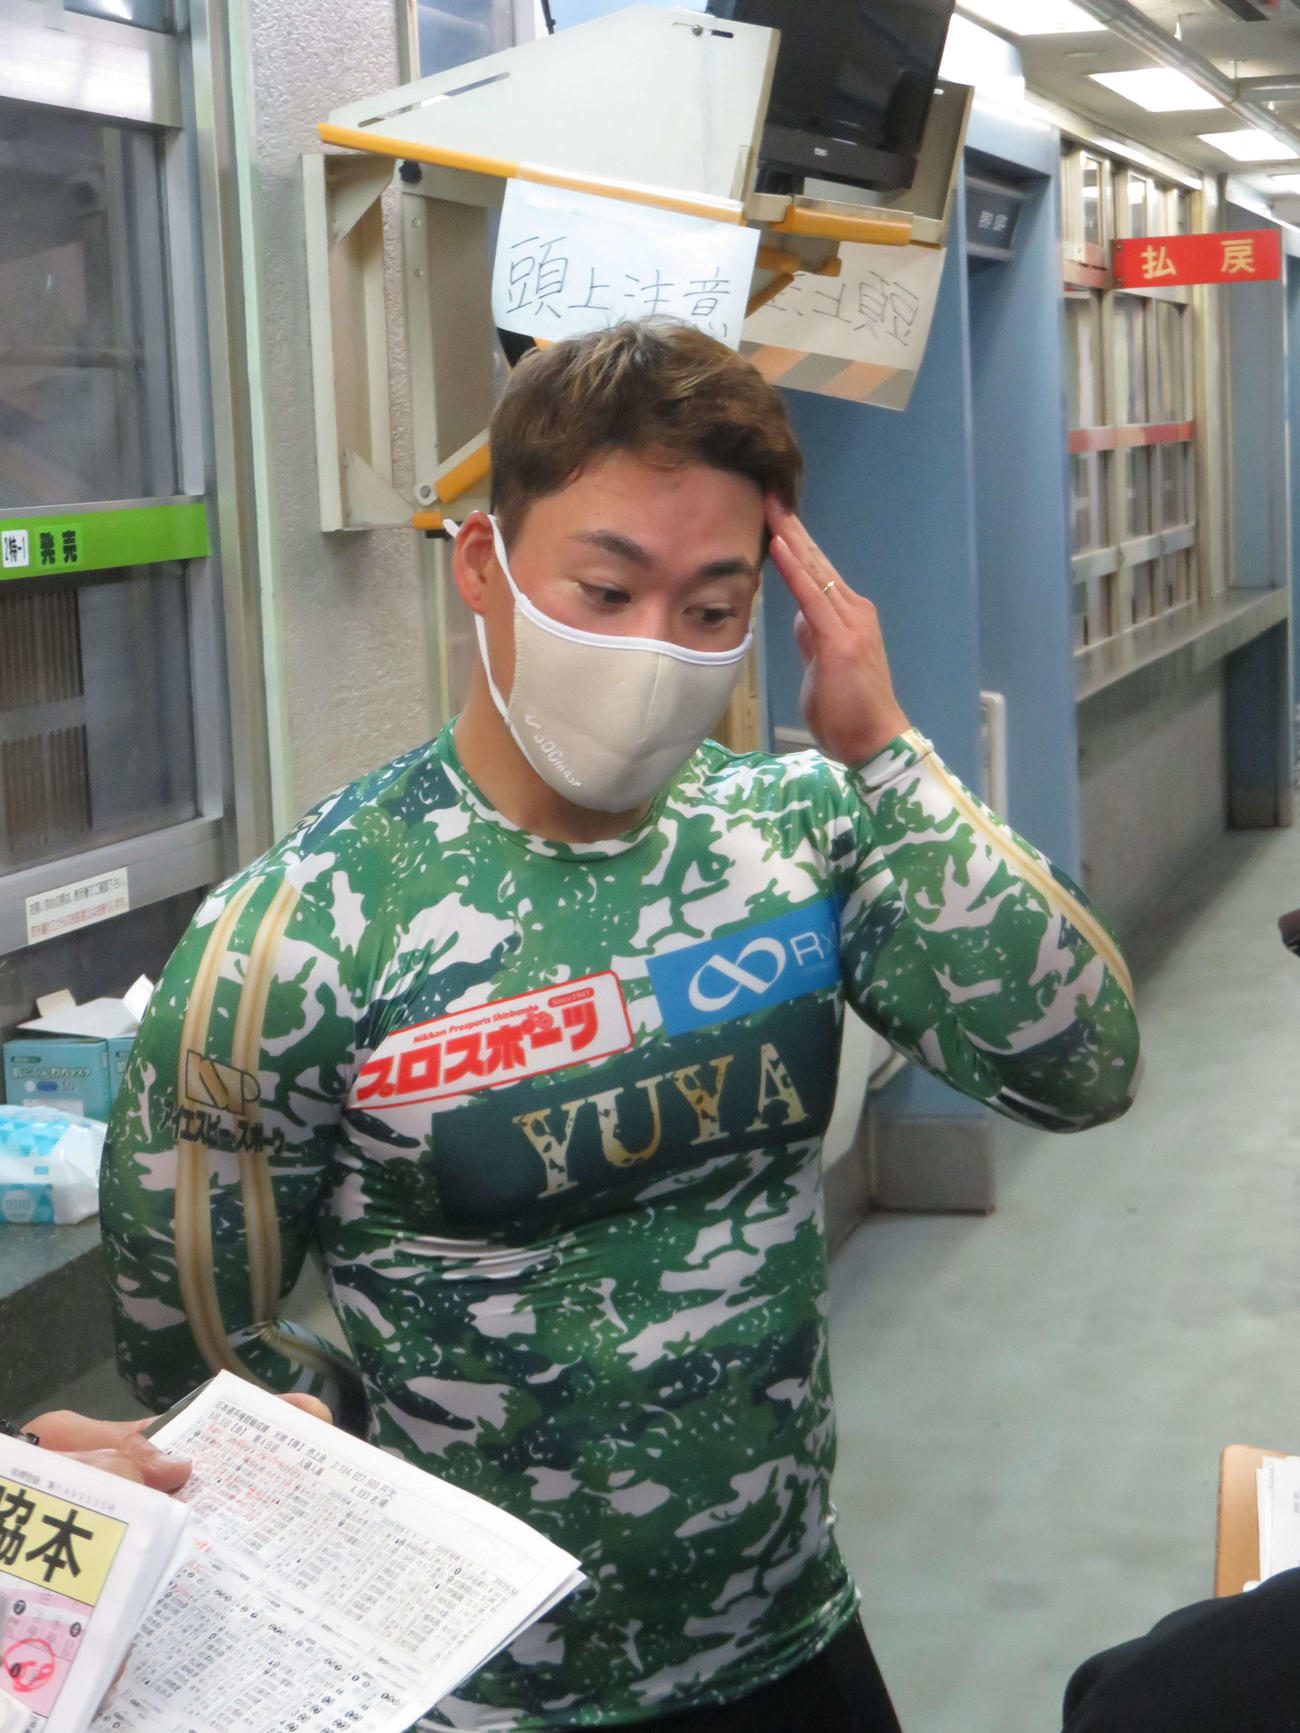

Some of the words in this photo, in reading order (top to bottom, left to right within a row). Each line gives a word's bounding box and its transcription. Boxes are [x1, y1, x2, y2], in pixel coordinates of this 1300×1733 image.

[355, 1000, 599, 1102] プロスポーツ
[413, 1028, 447, 1044] Nikkan
[448, 1016, 492, 1035] Prosports
[511, 1042, 810, 1200] YUYA
